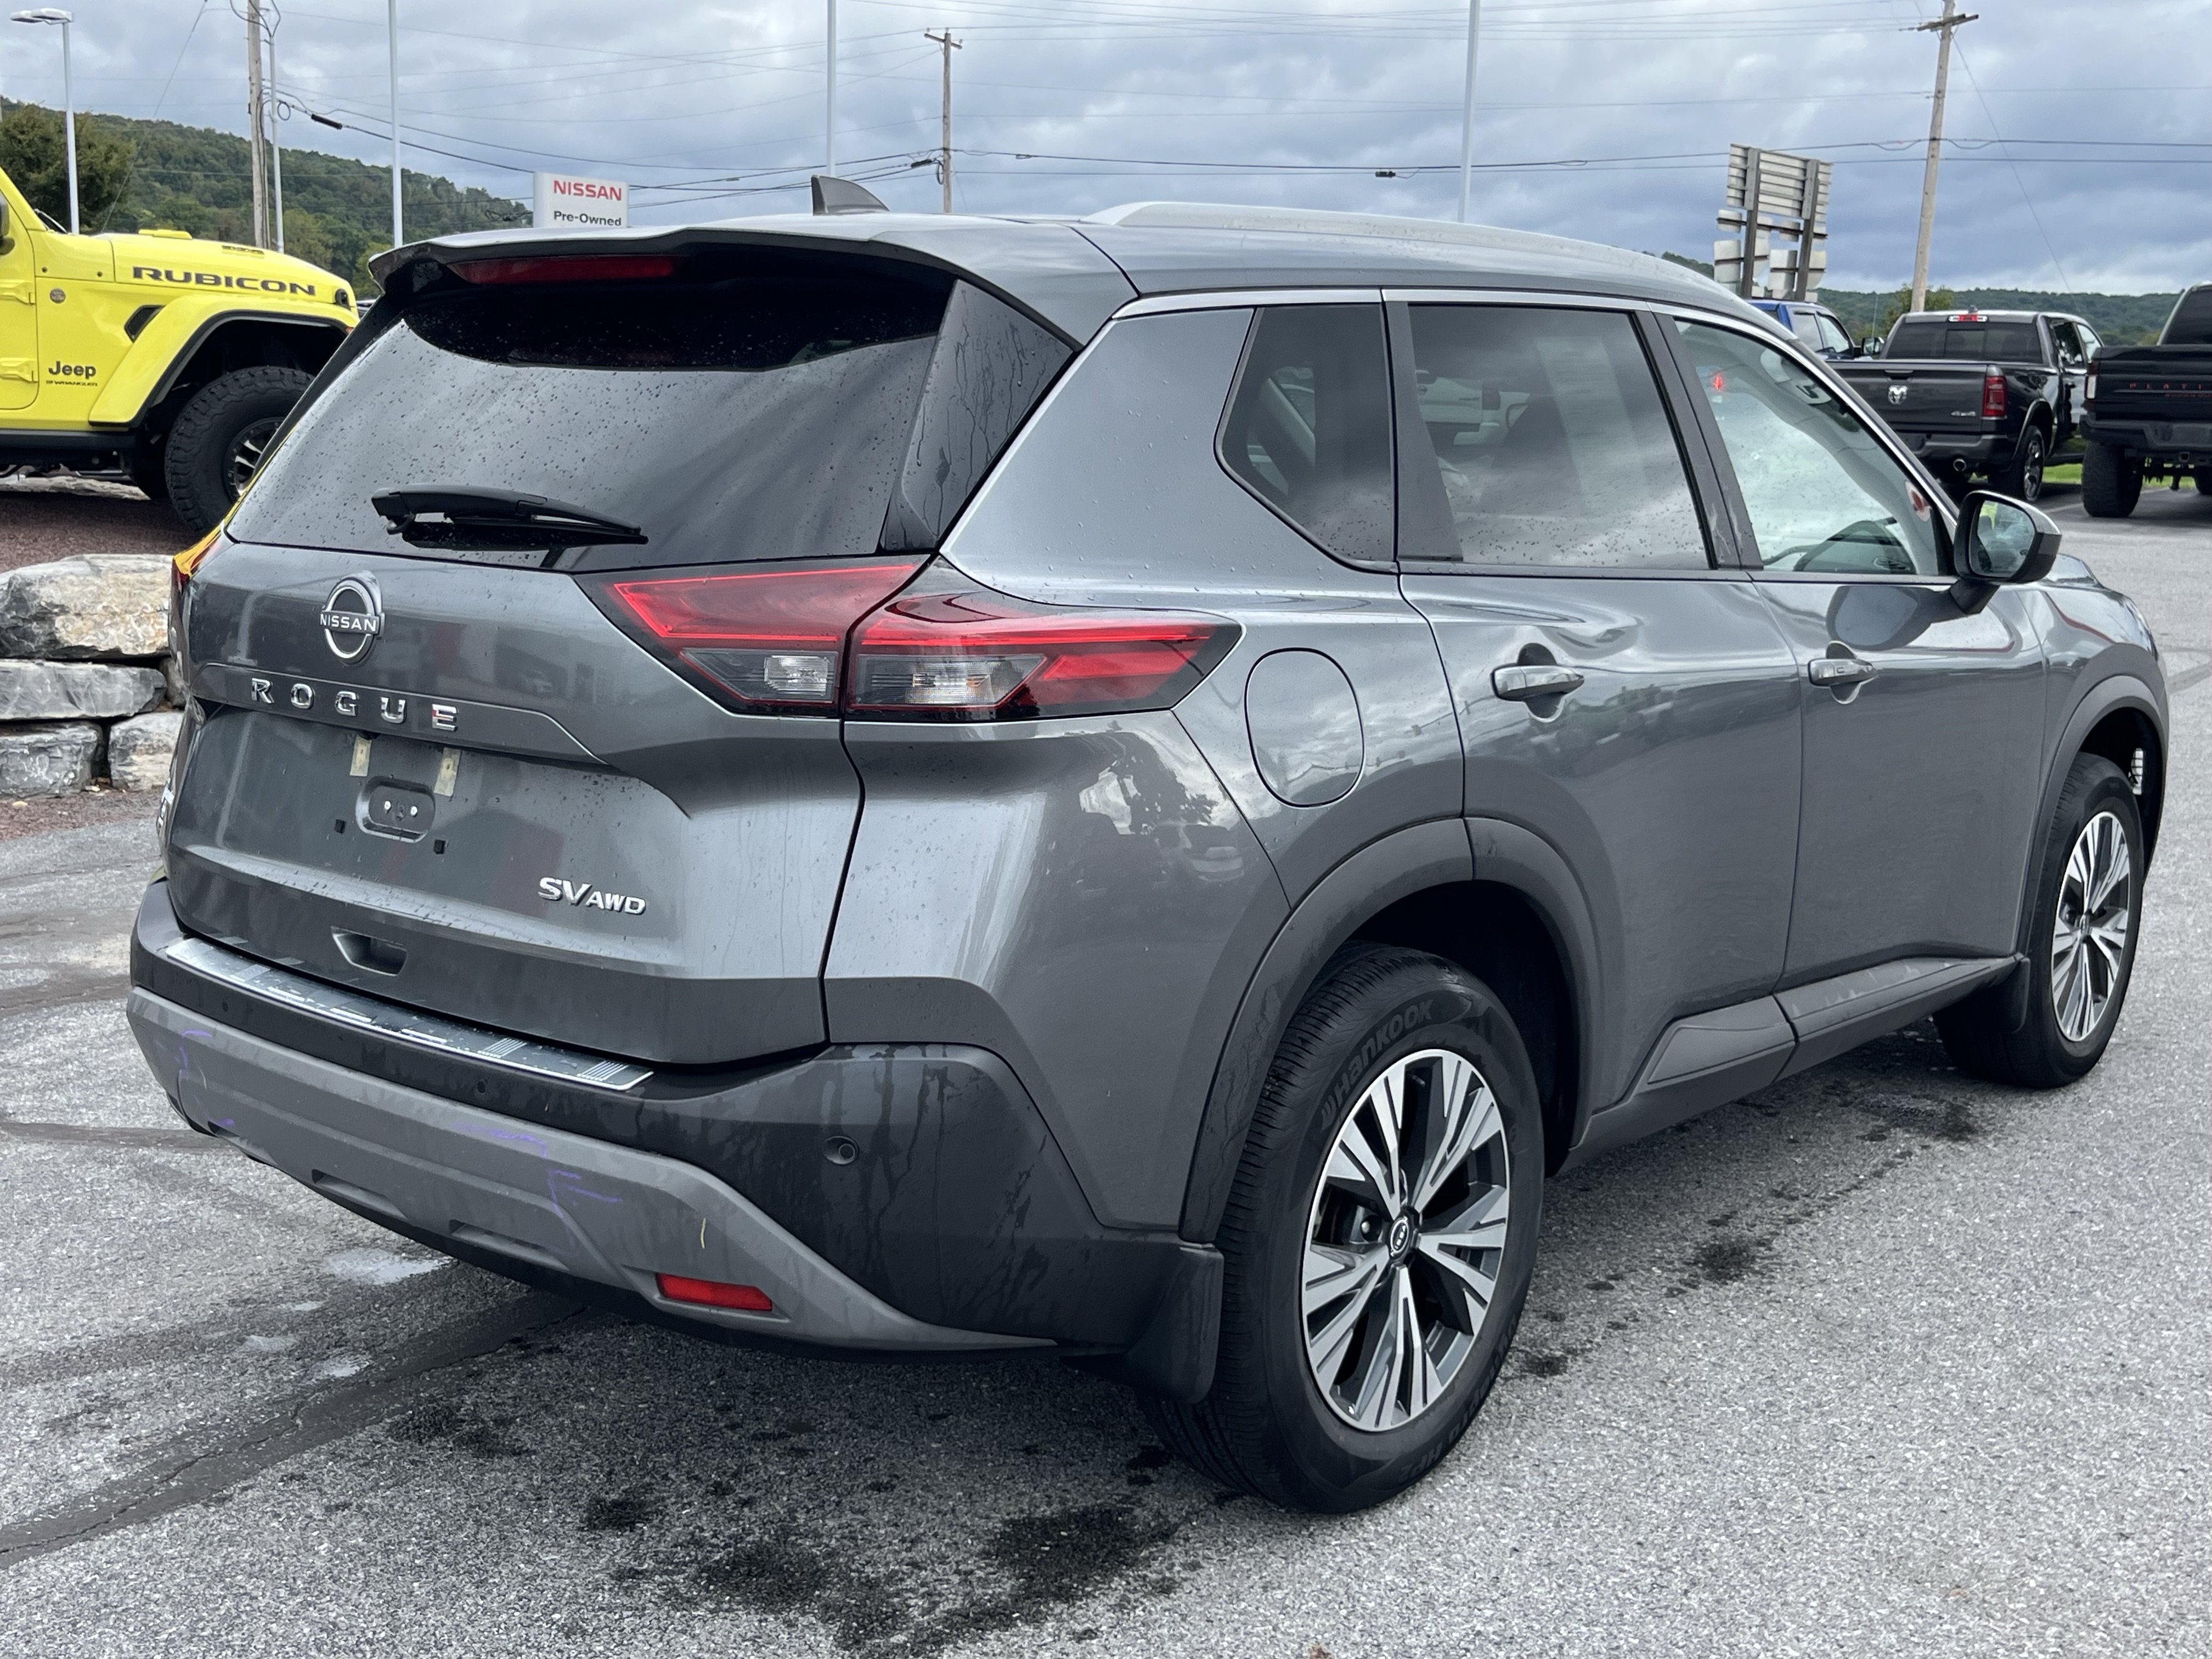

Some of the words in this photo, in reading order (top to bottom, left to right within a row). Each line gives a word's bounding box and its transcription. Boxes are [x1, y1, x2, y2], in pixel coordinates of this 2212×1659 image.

[554, 180, 622, 201] NISSAN
[554, 211, 622, 226] Pre-Owned
[132, 266, 316, 296] RUBICON
[48, 360, 97, 380] Jeep
[320, 613, 376, 632] NISSAN
[251, 677, 458, 732] ROGUE
[538, 877, 592, 906] SV
[585, 891, 647, 915] AWD
